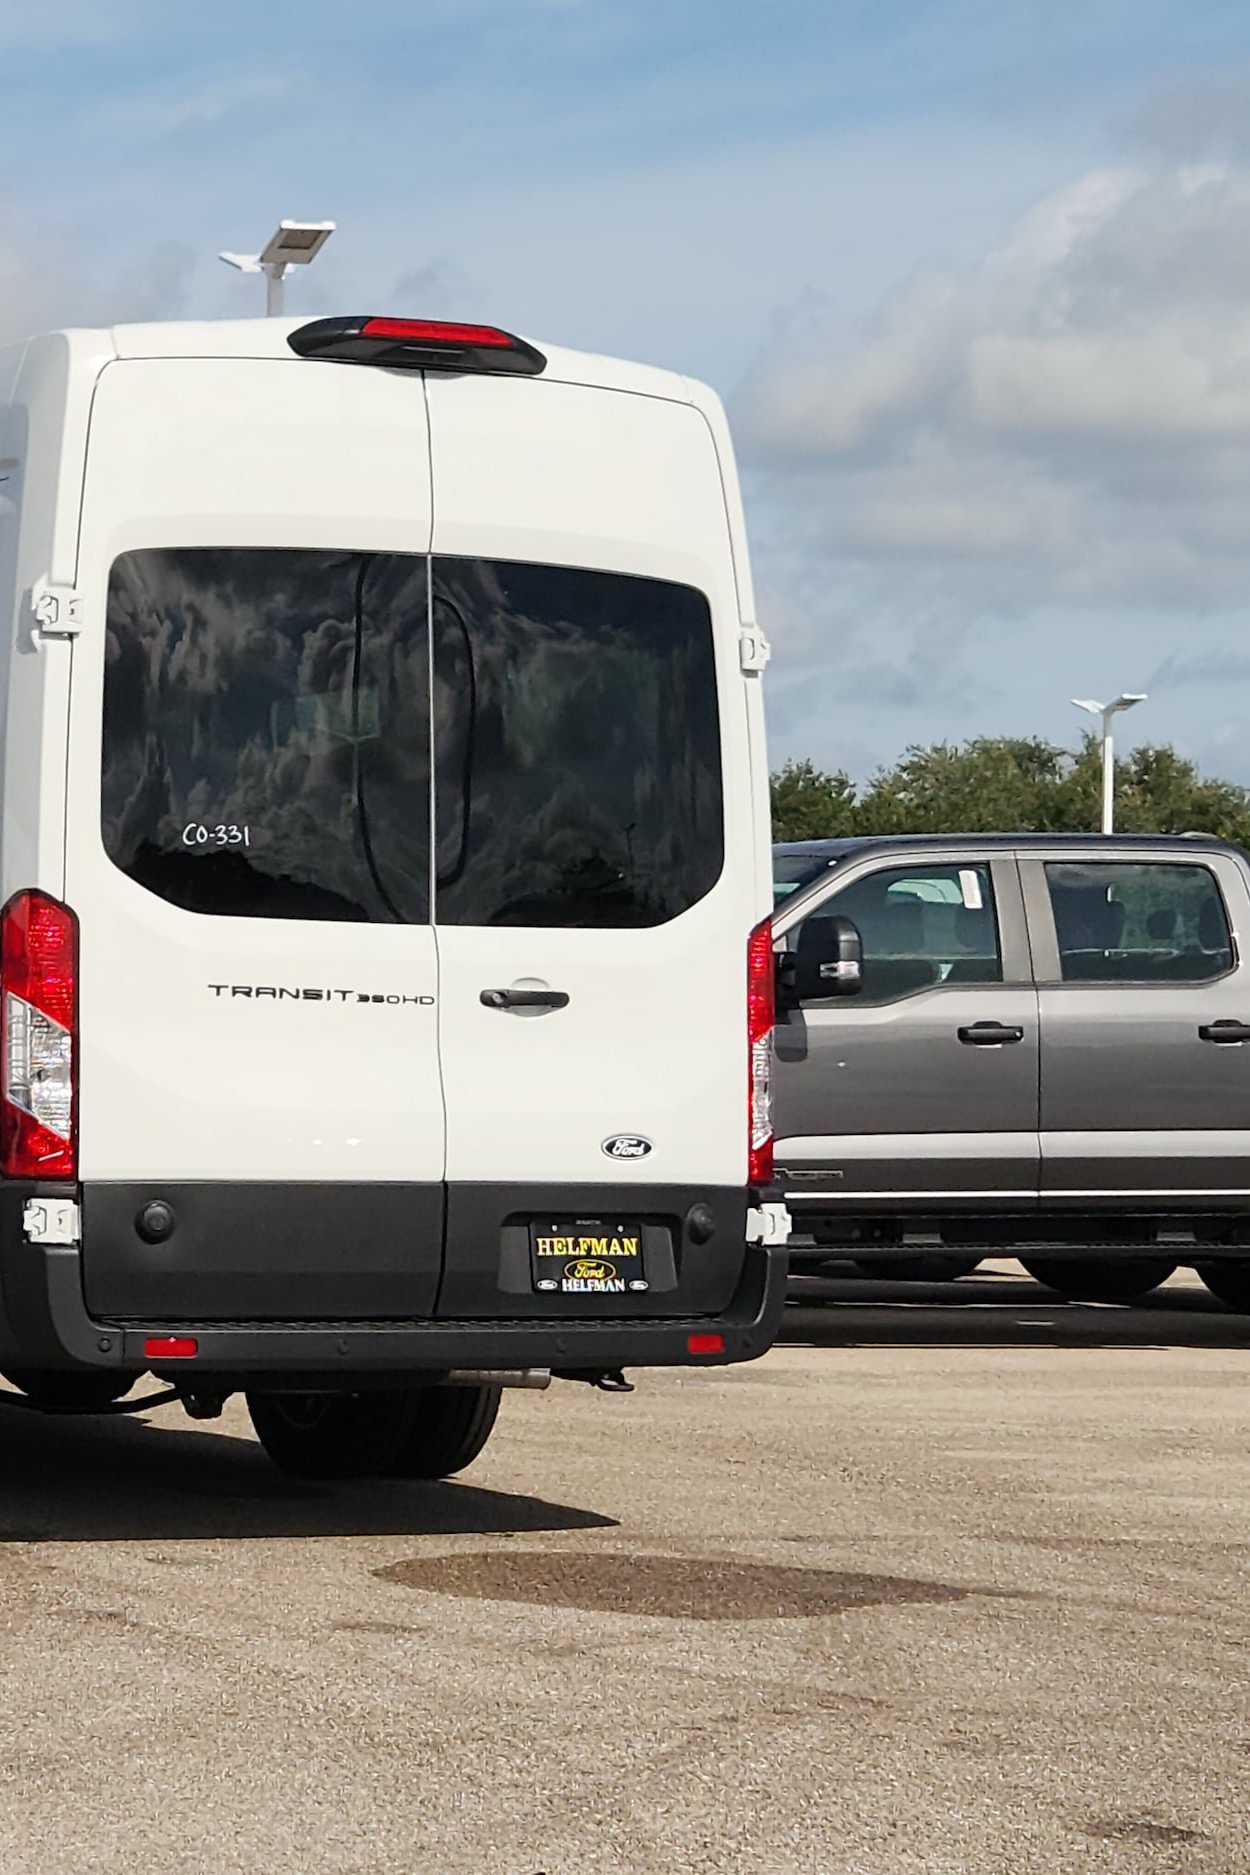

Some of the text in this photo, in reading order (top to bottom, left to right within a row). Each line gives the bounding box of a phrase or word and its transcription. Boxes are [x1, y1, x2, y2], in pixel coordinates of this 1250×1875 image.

[182, 822, 250, 846] CO-331
[207, 984, 355, 1002] TRANSIT
[536, 1237, 638, 1256] HELFMAN
[574, 1262, 606, 1278] Ford
[561, 1278, 626, 1292] HELFMAN
